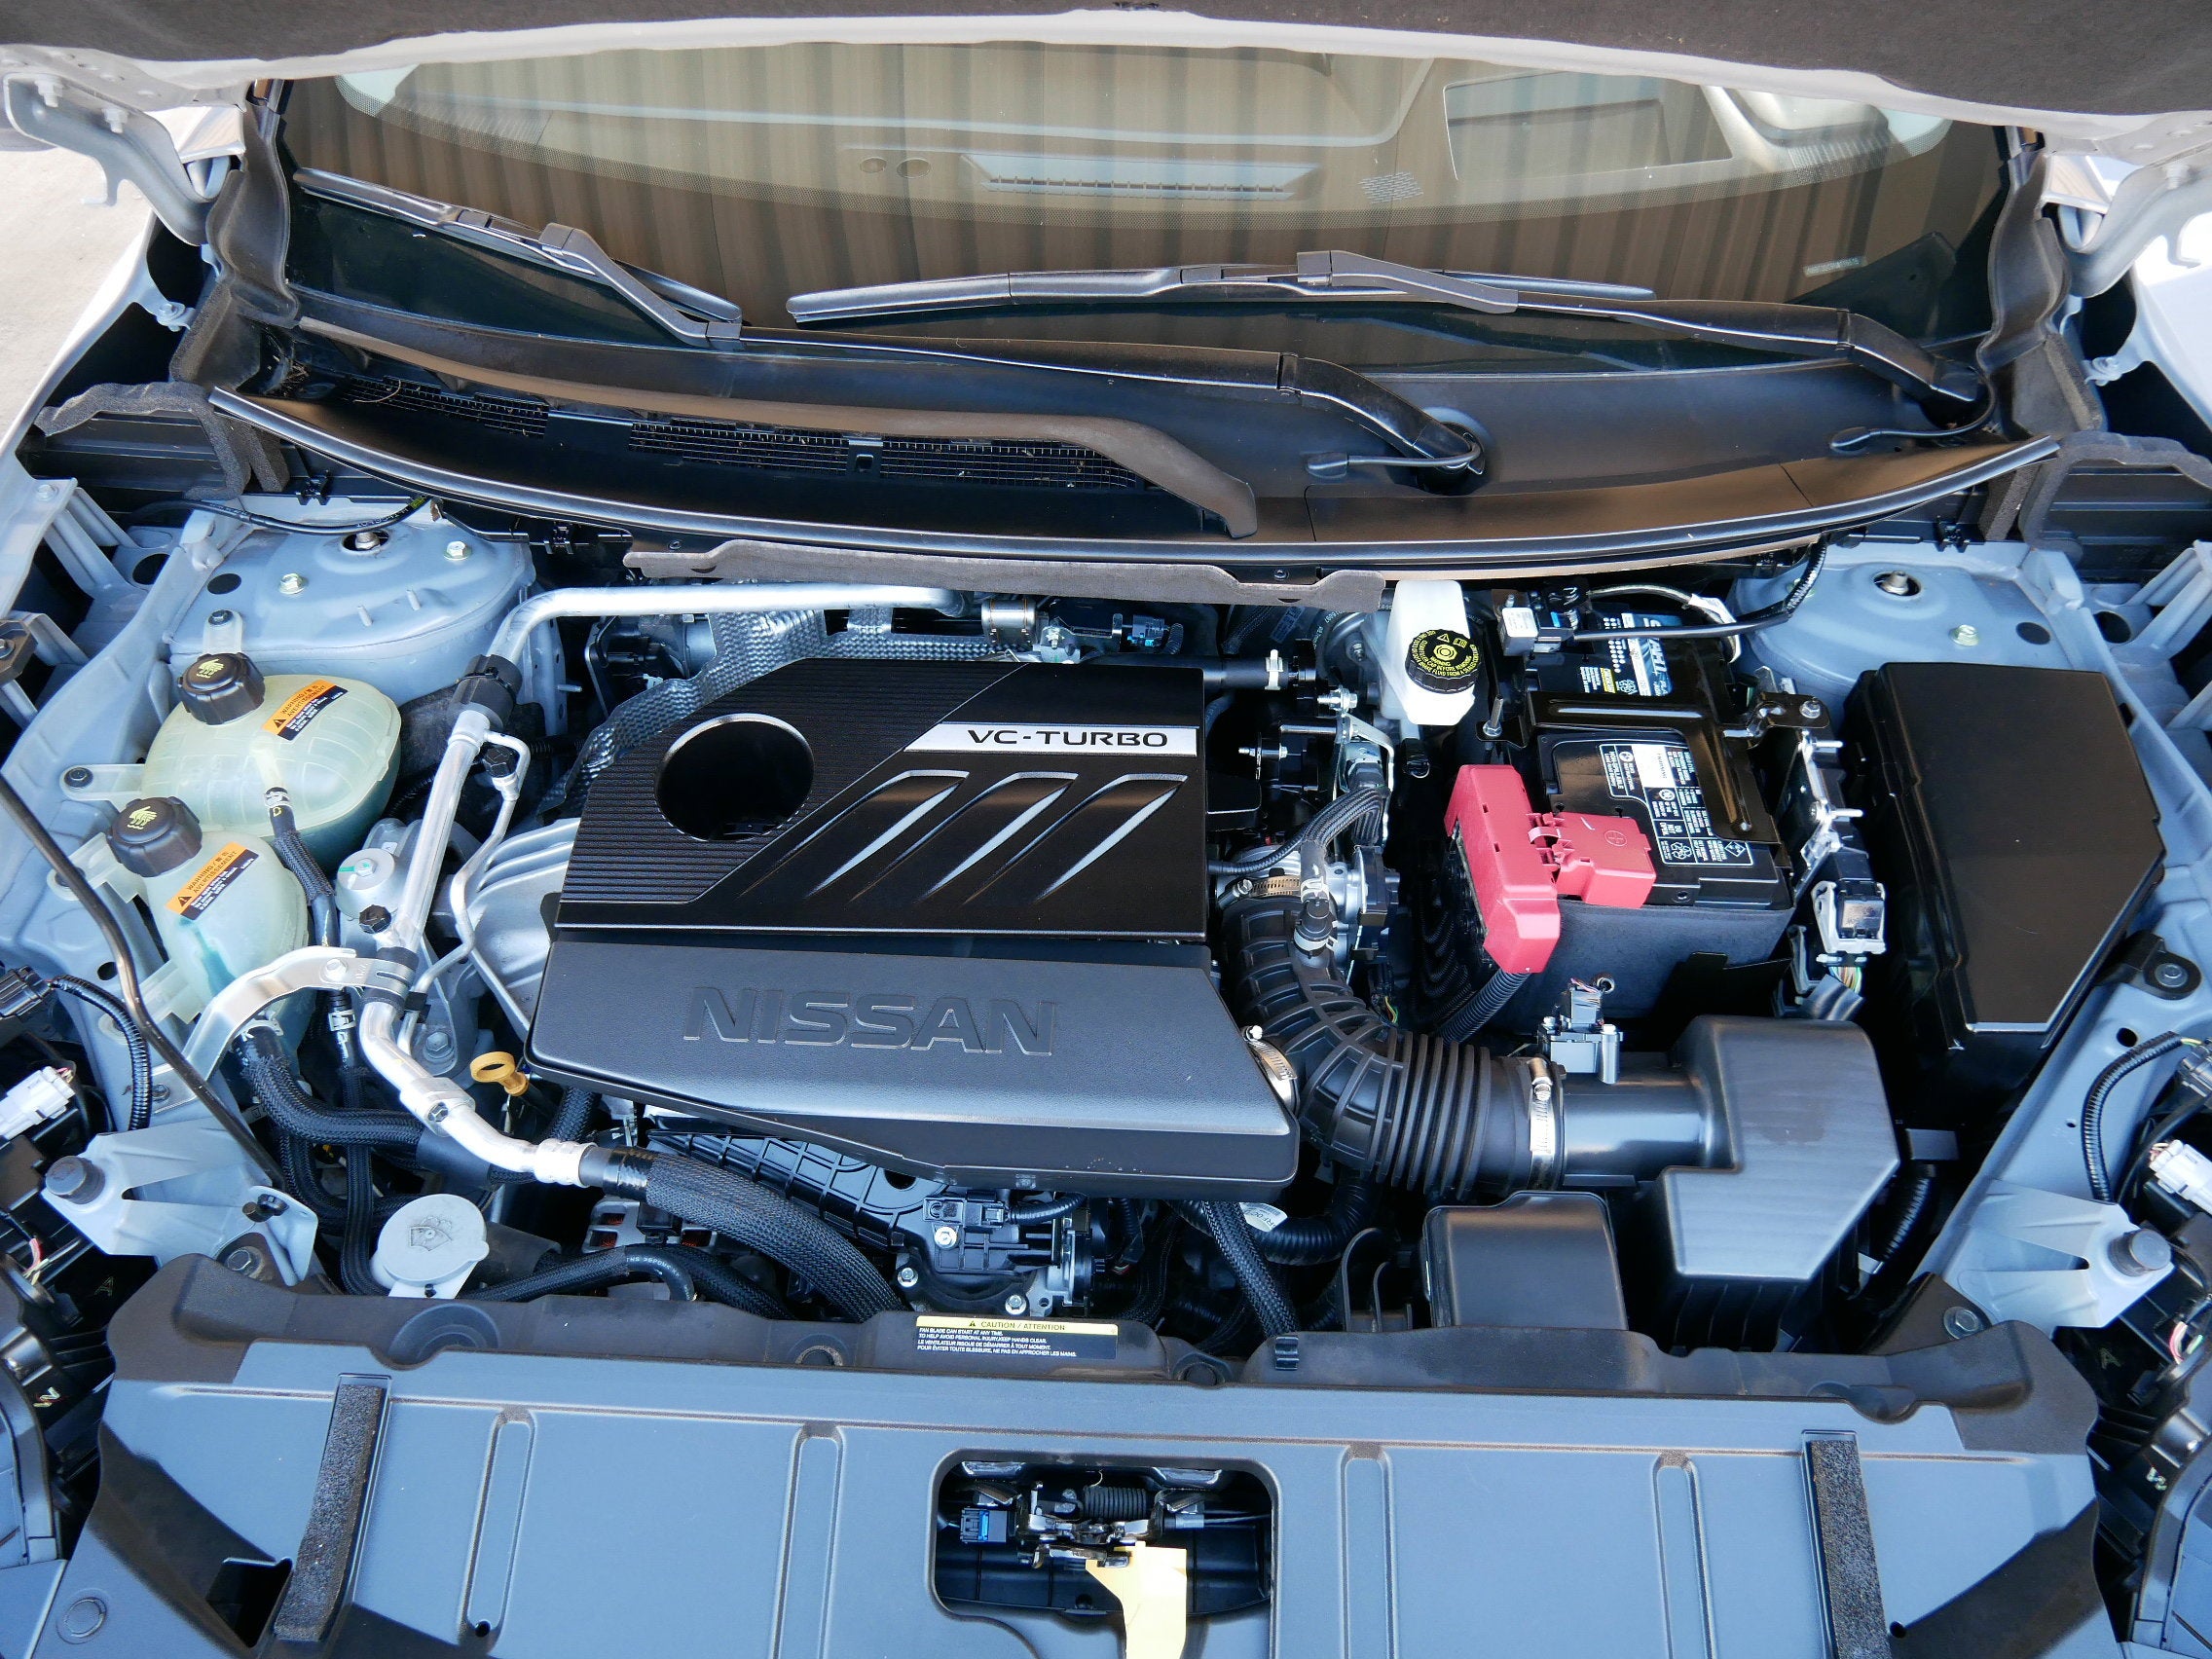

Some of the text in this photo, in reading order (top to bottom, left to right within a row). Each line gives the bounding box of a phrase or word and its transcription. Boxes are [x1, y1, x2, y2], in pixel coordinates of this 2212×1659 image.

[966, 728, 1169, 748] VC-TURBO
[683, 986, 1056, 1056] NISSAN
[1023, 1323, 1065, 1331] ATTENTION
